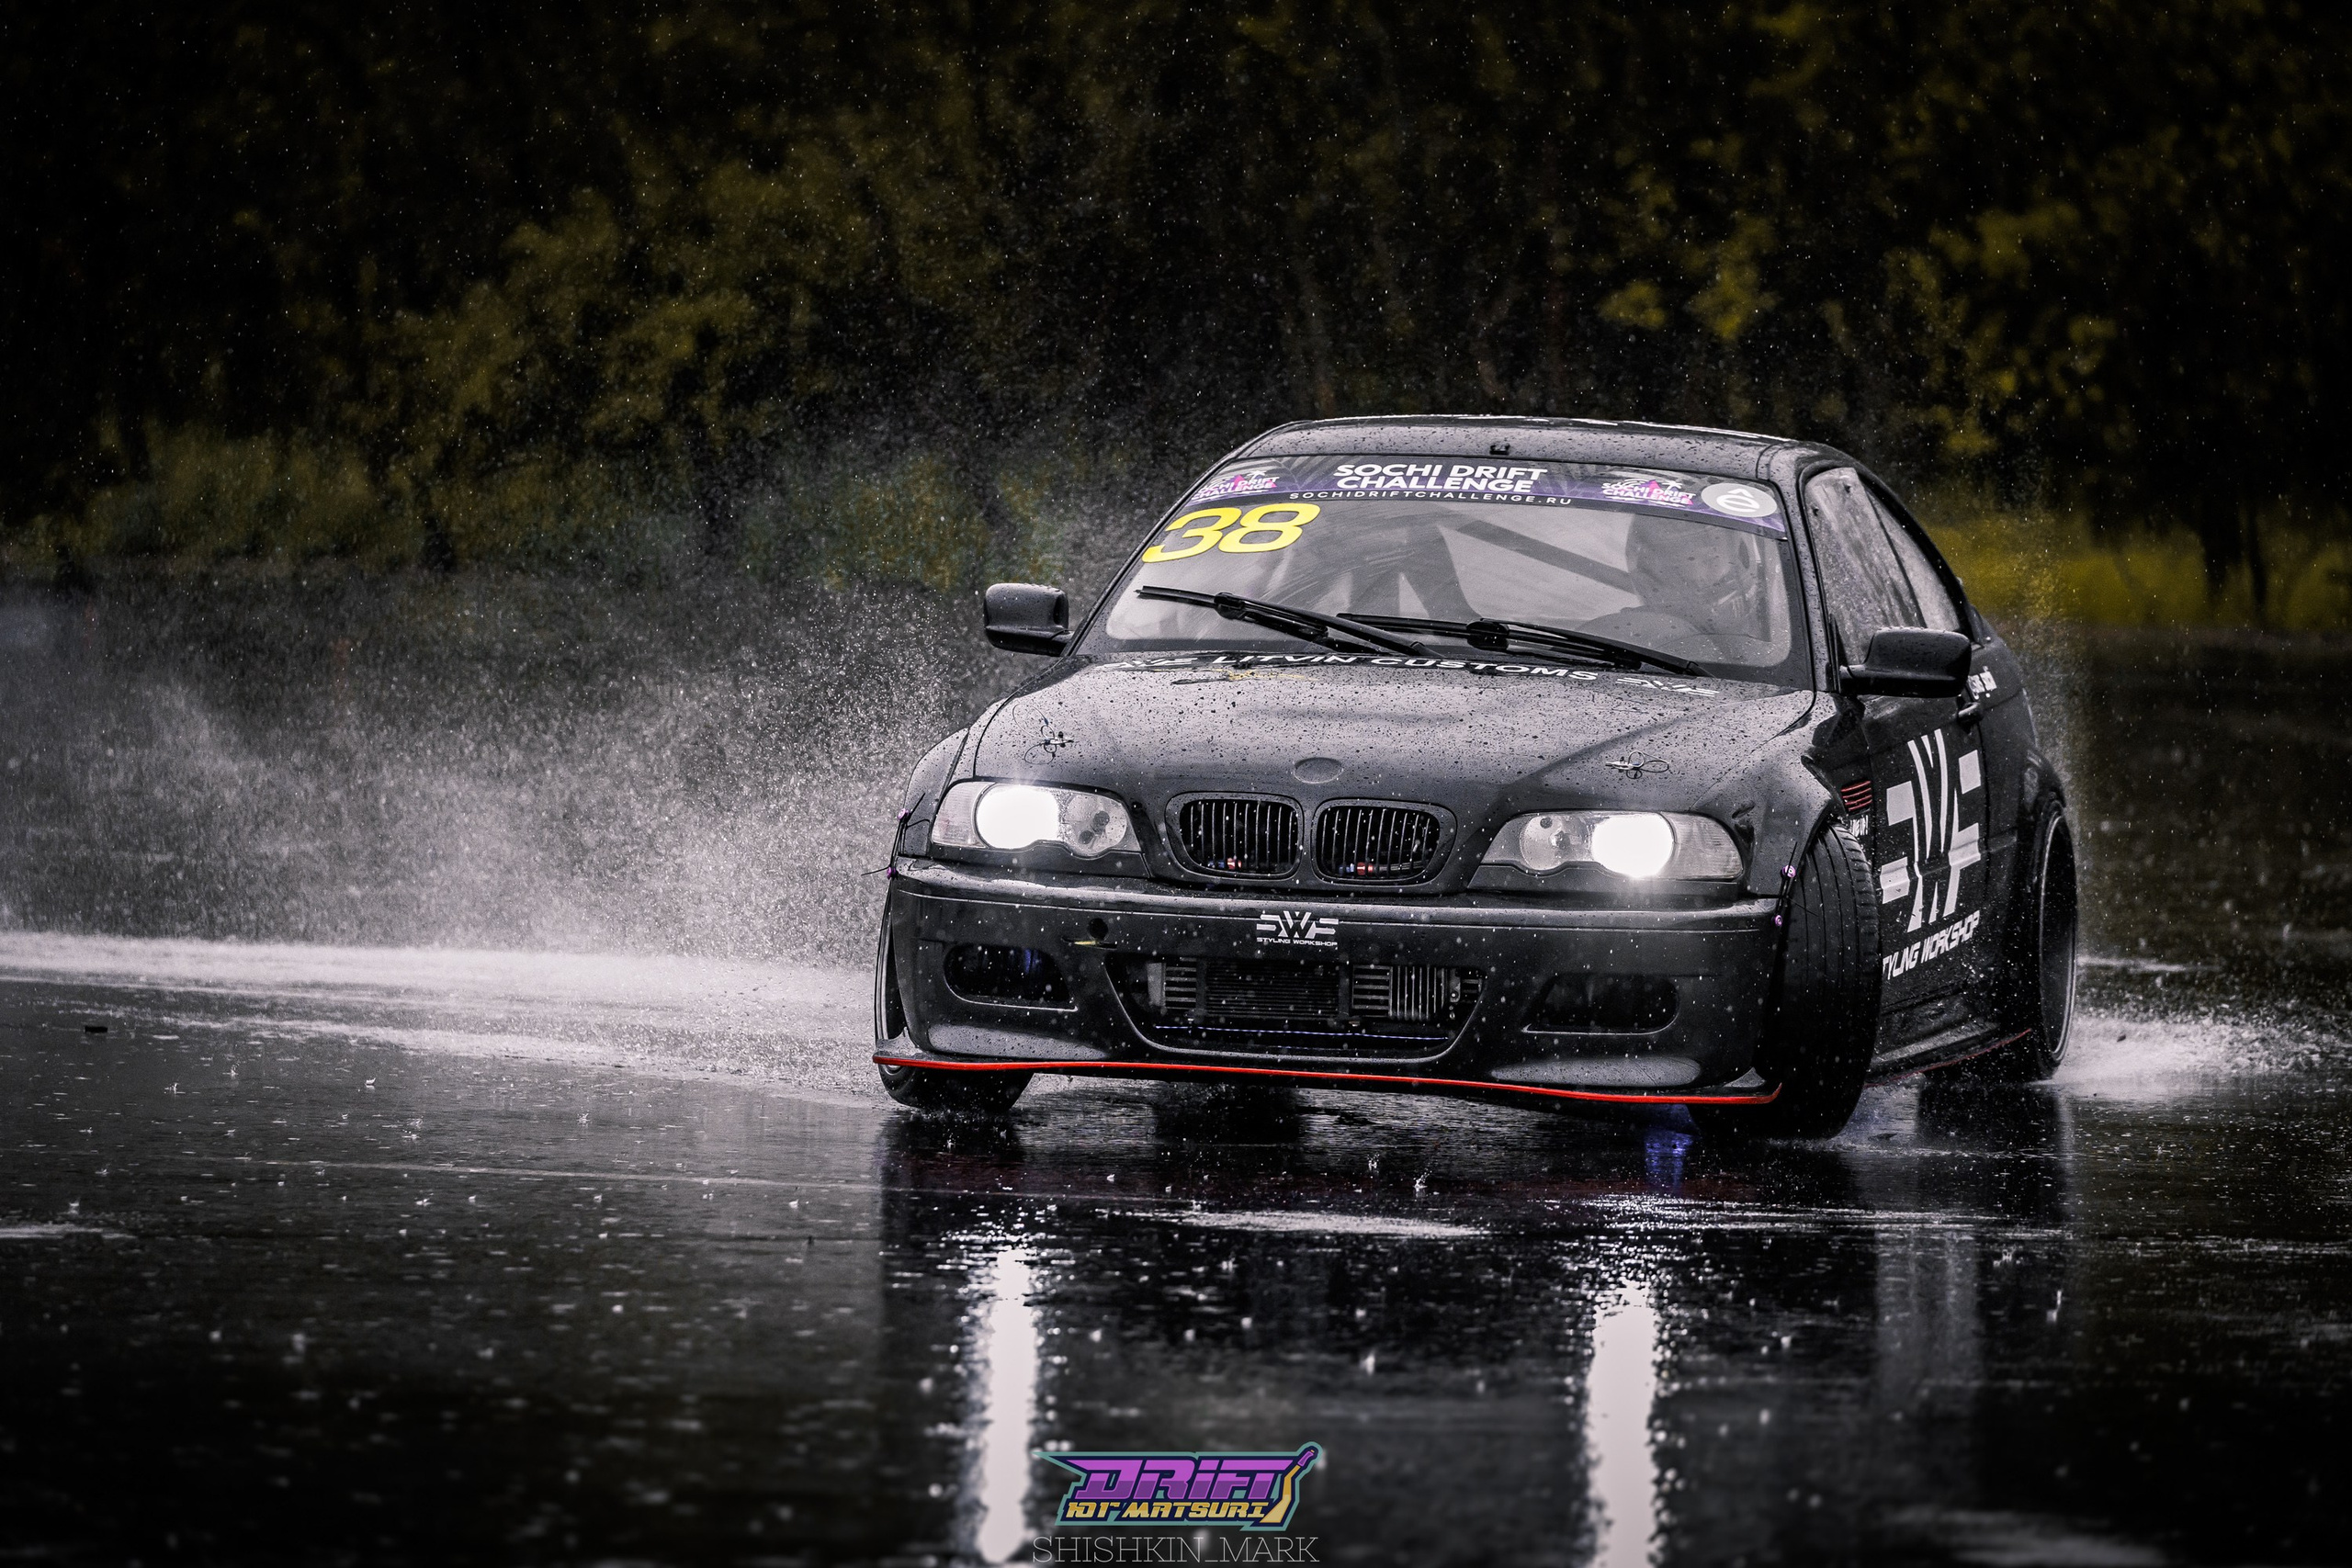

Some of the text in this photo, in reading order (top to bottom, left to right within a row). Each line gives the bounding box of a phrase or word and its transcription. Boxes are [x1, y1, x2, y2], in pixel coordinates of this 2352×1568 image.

[1333, 464, 1548, 480] SOCHI DRIFT
[1336, 476, 1533, 493] CHALLENGE
[1600, 482, 1697, 501] SOCHI DRIFT
[1289, 491, 1572, 505] SOCHIDRIFTCHALLENGE.RU
[1602, 489, 1691, 506] CHALLENGE
[1141, 502, 1321, 563] 38
[1212, 655, 1358, 663] LITVIN
[1370, 658, 1600, 681] CUSTOMS
[1293, 939, 1339, 947] WORKSHOP
[1883, 909, 1981, 980] TYLING WORKSHOP
